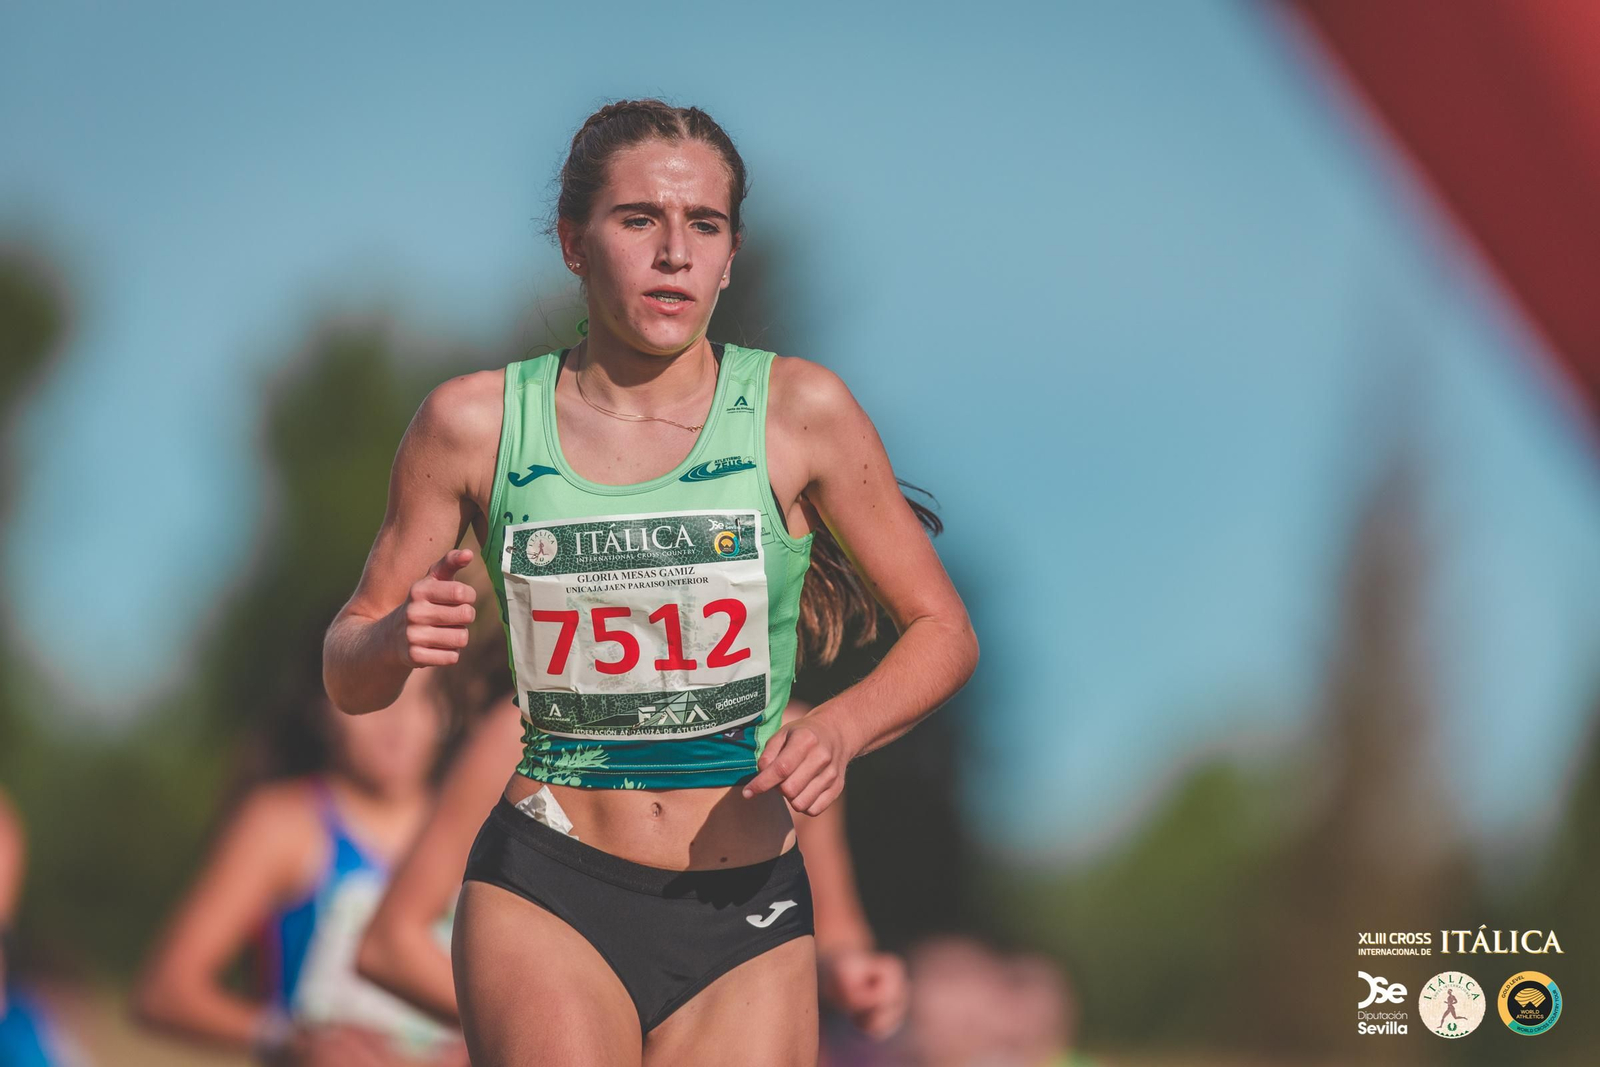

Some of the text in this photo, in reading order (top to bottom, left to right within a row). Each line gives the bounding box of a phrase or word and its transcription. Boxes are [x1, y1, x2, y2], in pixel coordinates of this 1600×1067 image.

[714, 459, 743, 471] ZEUS
[575, 522, 695, 556] ITÁLICA
[576, 553, 634, 563] INTERNATIONAL
[661, 549, 695, 557] COUNTRY
[577, 566, 695, 584] GLORIA MESAS GAMIZ
[566, 576, 709, 594] UNICAJA JAEN PARAISO INTERIOR
[532, 598, 751, 675] 7512
[723, 691, 758, 707] docunova
[676, 722, 718, 733] ATLETISMO
